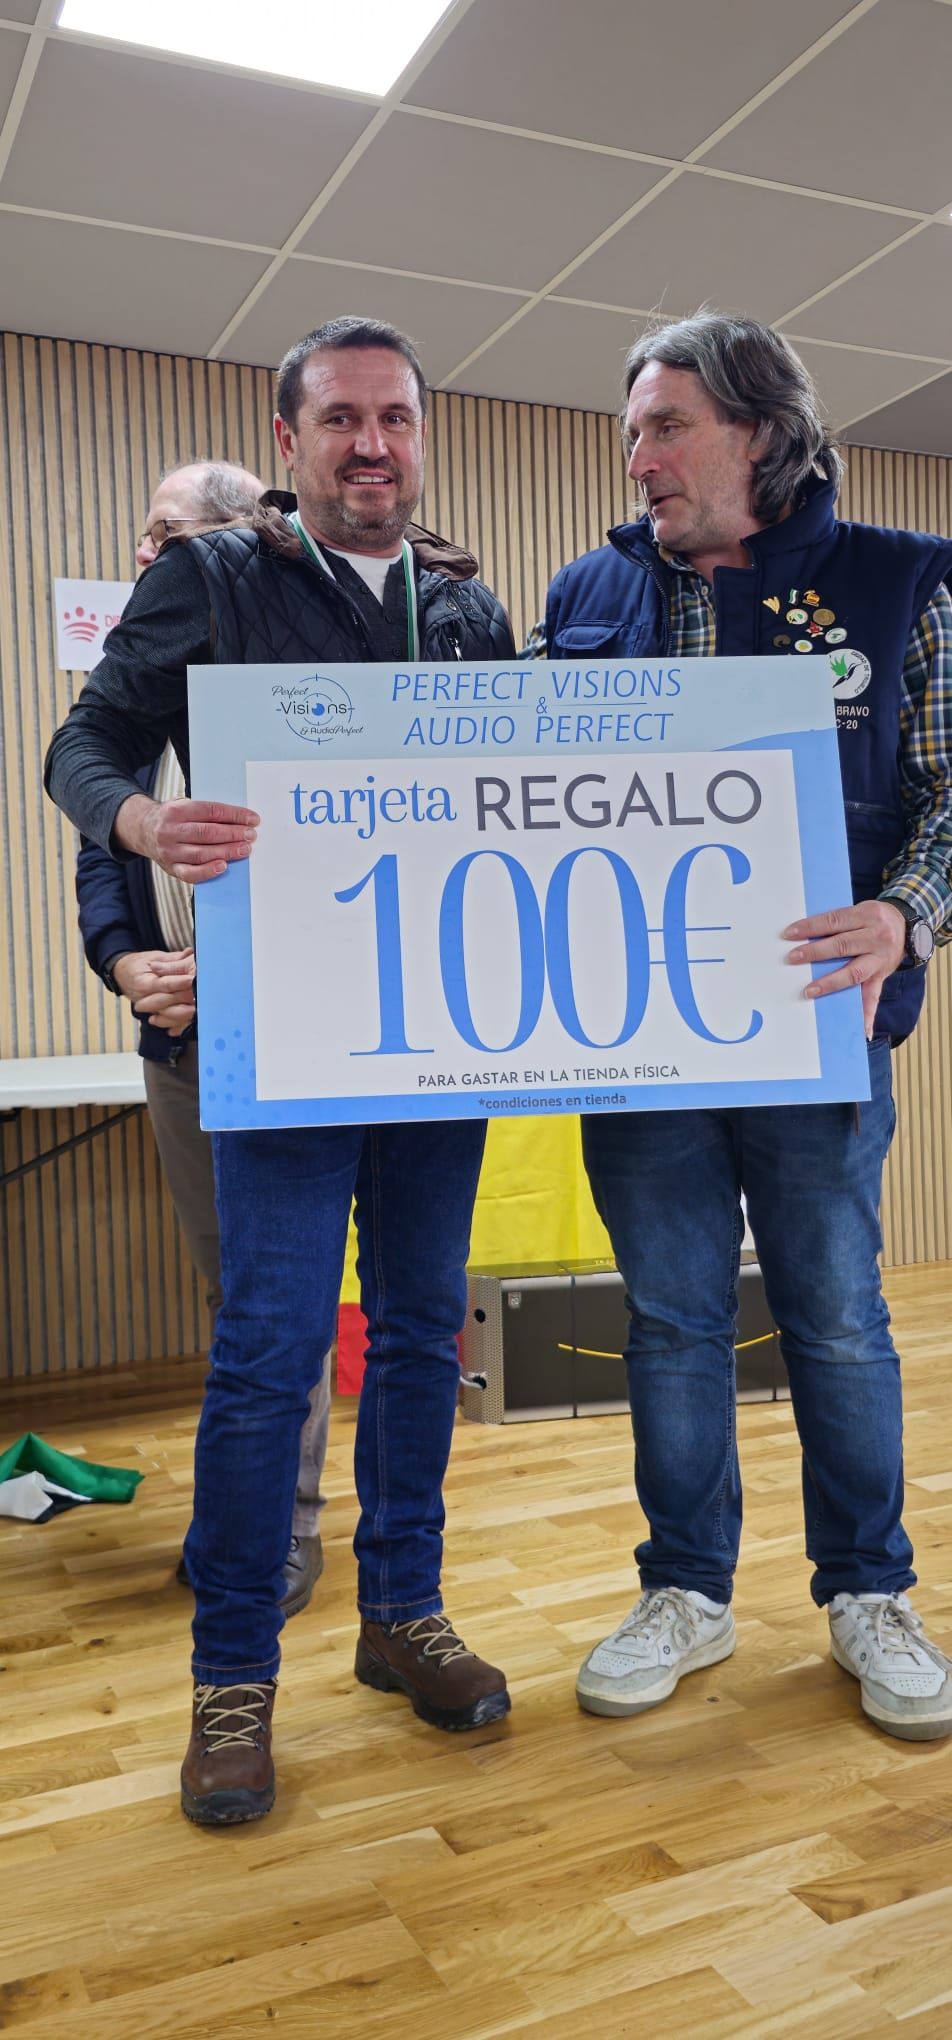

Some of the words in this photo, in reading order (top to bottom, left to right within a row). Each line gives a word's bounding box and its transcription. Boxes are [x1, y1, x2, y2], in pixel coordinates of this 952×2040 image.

[271, 685, 309, 699] Perfect
[392, 671, 532, 701] PERFECT
[551, 669, 681, 699] VISIONS
[536, 696, 548, 714] &
[836, 705, 870, 717] BRAVO
[403, 715, 516, 746] AUDIO
[535, 713, 674, 743] PERFECT
[290, 775, 457, 839] tarjeta
[475, 770, 762, 831] REGALO
[334, 843, 764, 1056] 100€
[418, 1074, 456, 1087] PARA
[461, 1072, 518, 1086] GASTAR
[524, 1070, 544, 1083] EN
[550, 1070, 569, 1082] LA
[573, 1067, 629, 1081] TIENDA
[634, 1064, 680, 1078] FÍSICA
[565, 1097, 582, 1106] en
[585, 1093, 627, 1105] tienda
